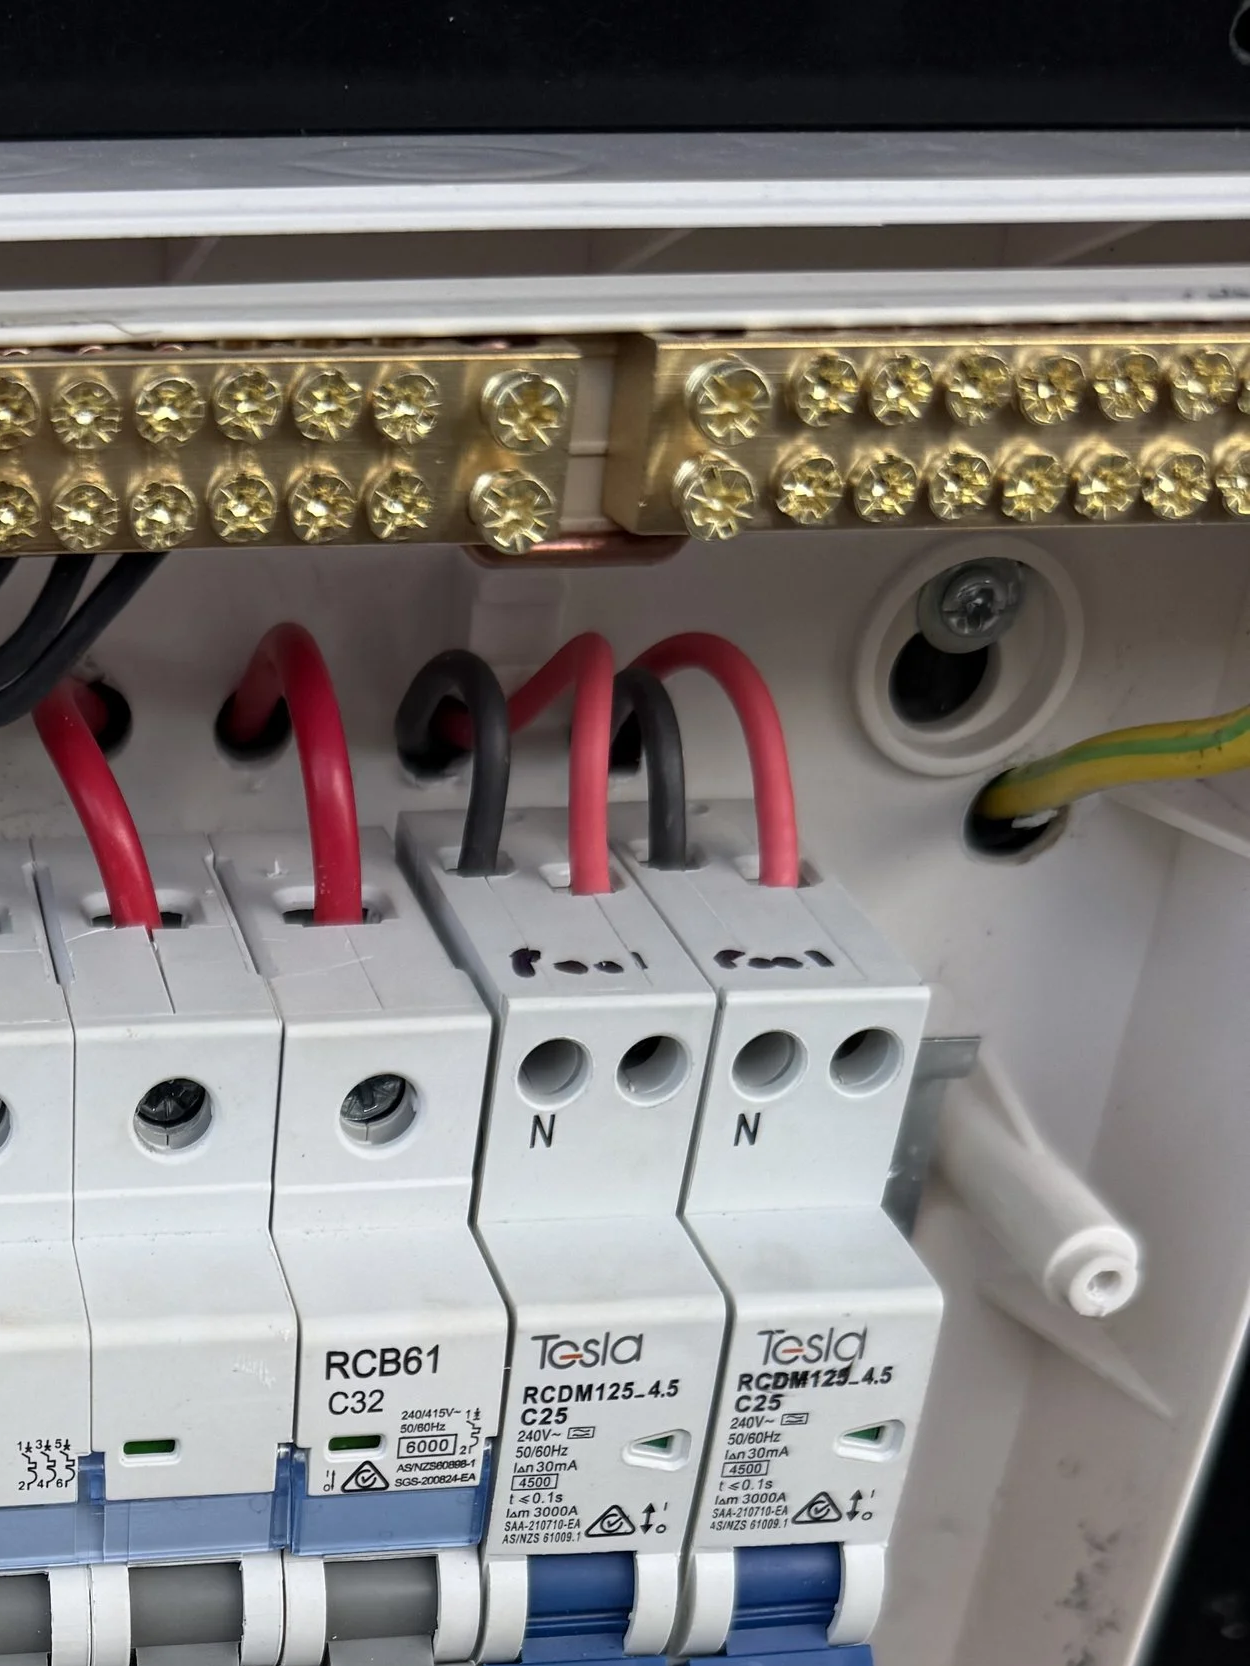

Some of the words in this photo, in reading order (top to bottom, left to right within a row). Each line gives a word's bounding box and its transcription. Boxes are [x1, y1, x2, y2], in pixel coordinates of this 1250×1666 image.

[530, 1114, 556, 1149] N
[733, 1112, 762, 1147] N
[531, 1331, 643, 1370] Tesla
[757, 1323, 868, 1366] Tesla
[325, 1343, 440, 1380] RCB61
[328, 1389, 384, 1415] C32
[734, 1393, 784, 1413] C25
[520, 1407, 568, 1426] C25
[400, 1422, 446, 1433] 50/60Hz
[36, 1439, 43, 1450] 3
[55, 1438, 62, 1449] 5
[727, 1431, 781, 1445] 50/60Hz
[406, 1438, 449, 1454] 6000
[515, 1445, 568, 1459] 50/60Hz
[747, 1447, 789, 1459] 30mA
[396, 1459, 476, 1473] AS/NZS60898-1
[536, 1460, 577, 1473] 30mA
[729, 1463, 762, 1475] 4500
[18, 1481, 26, 1490] 2
[37, 1479, 44, 1488] 4
[56, 1478, 63, 1488] 6
[394, 1473, 476, 1487] SGS-200824-EA
[519, 1477, 551, 1488] 4500
[742, 1492, 787, 1504] 3000A
[533, 1505, 578, 1517] 3000A
[712, 1505, 788, 1518] SAA-210710-EA
[504, 1518, 581, 1532] SAA-210710-EA
[750, 1518, 788, 1531] 61009.1
[502, 1532, 540, 1545] AS/NZS
[542, 1531, 581, 1544] 61009.1
